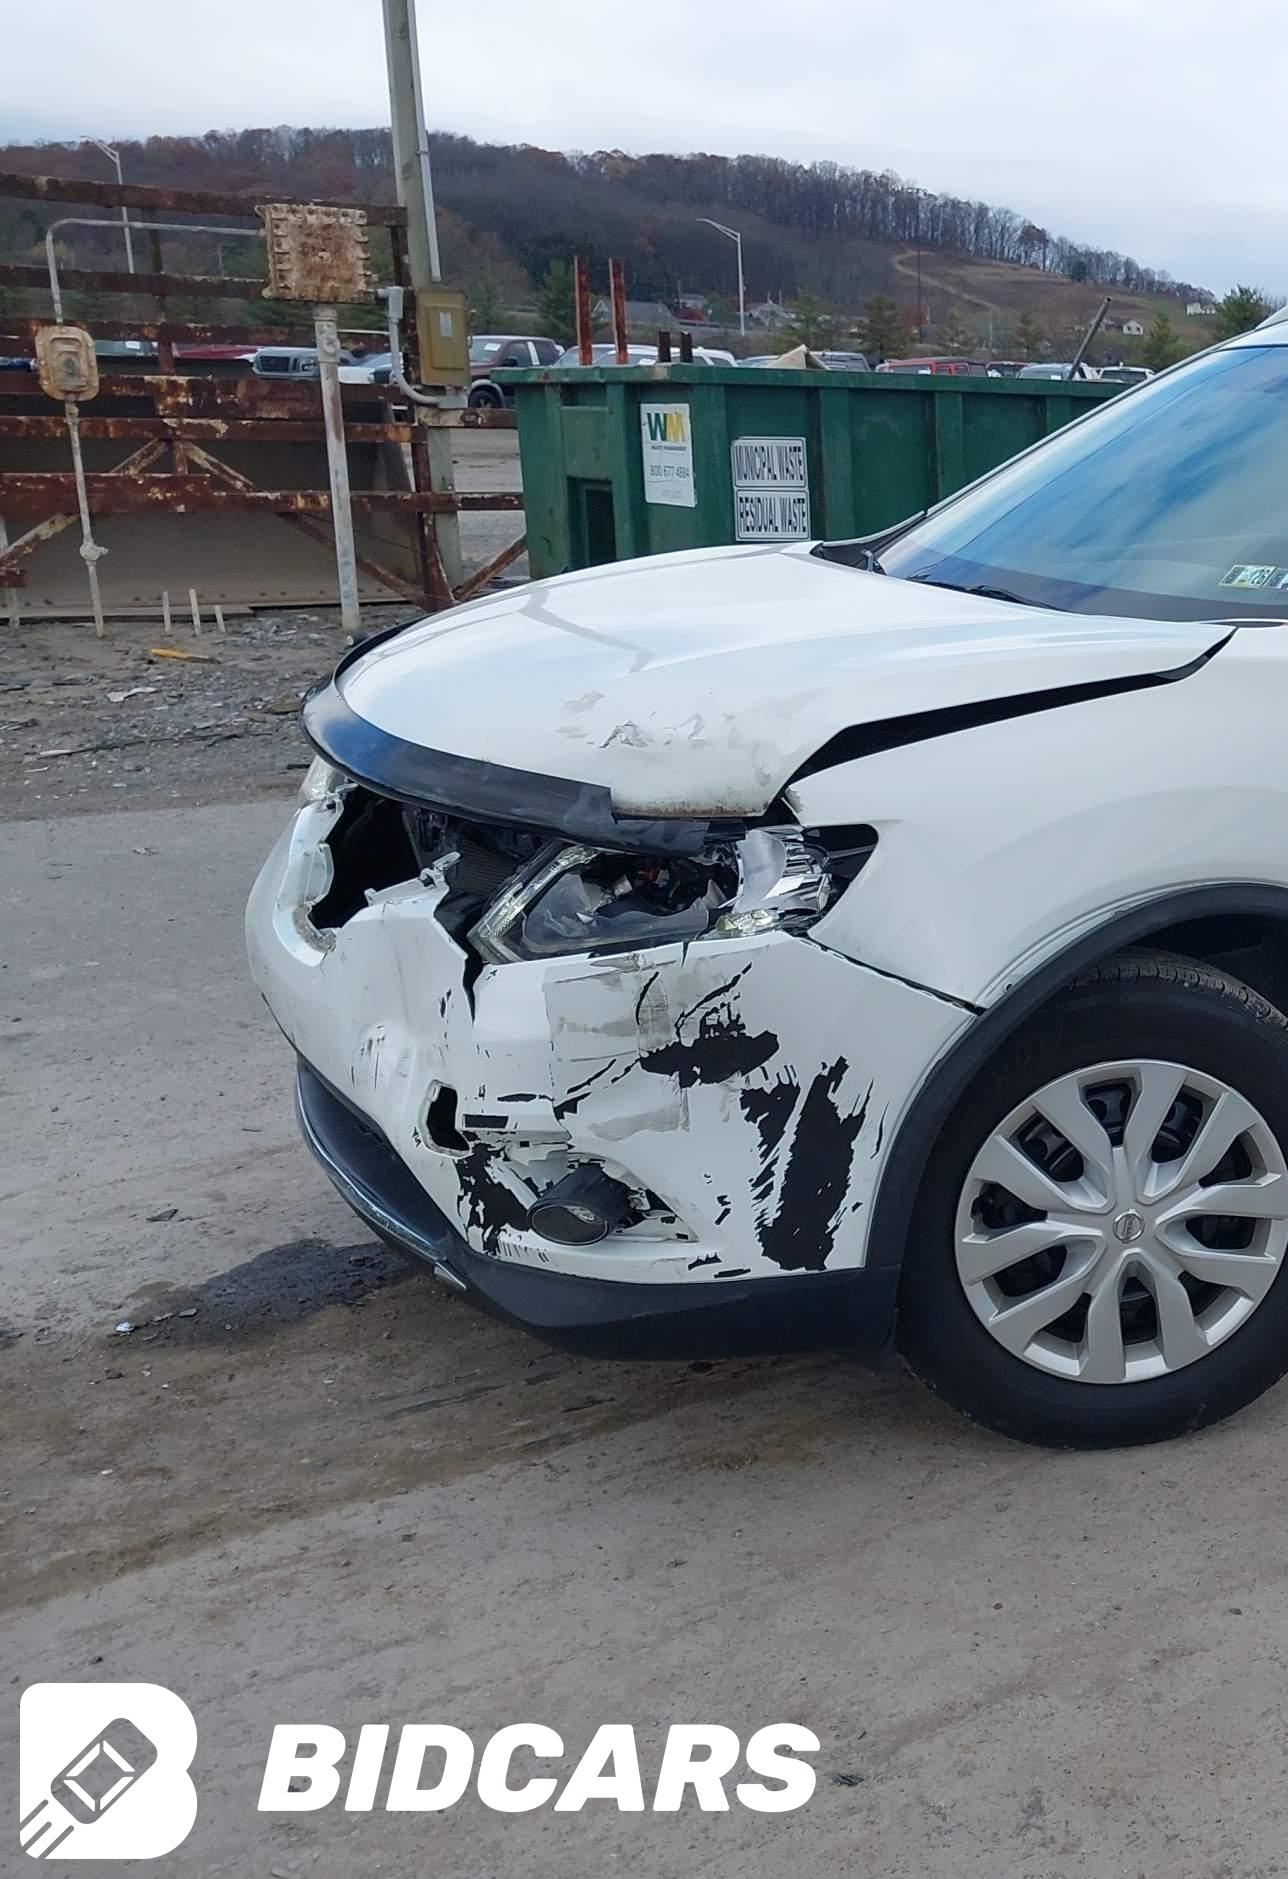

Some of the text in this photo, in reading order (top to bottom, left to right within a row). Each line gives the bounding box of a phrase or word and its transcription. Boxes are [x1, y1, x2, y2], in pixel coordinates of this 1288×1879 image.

[646, 412, 685, 442] WM
[734, 445, 804, 481] MUNICIPAL WASTE
[738, 496, 806, 533] RESIDUAL WASTE
